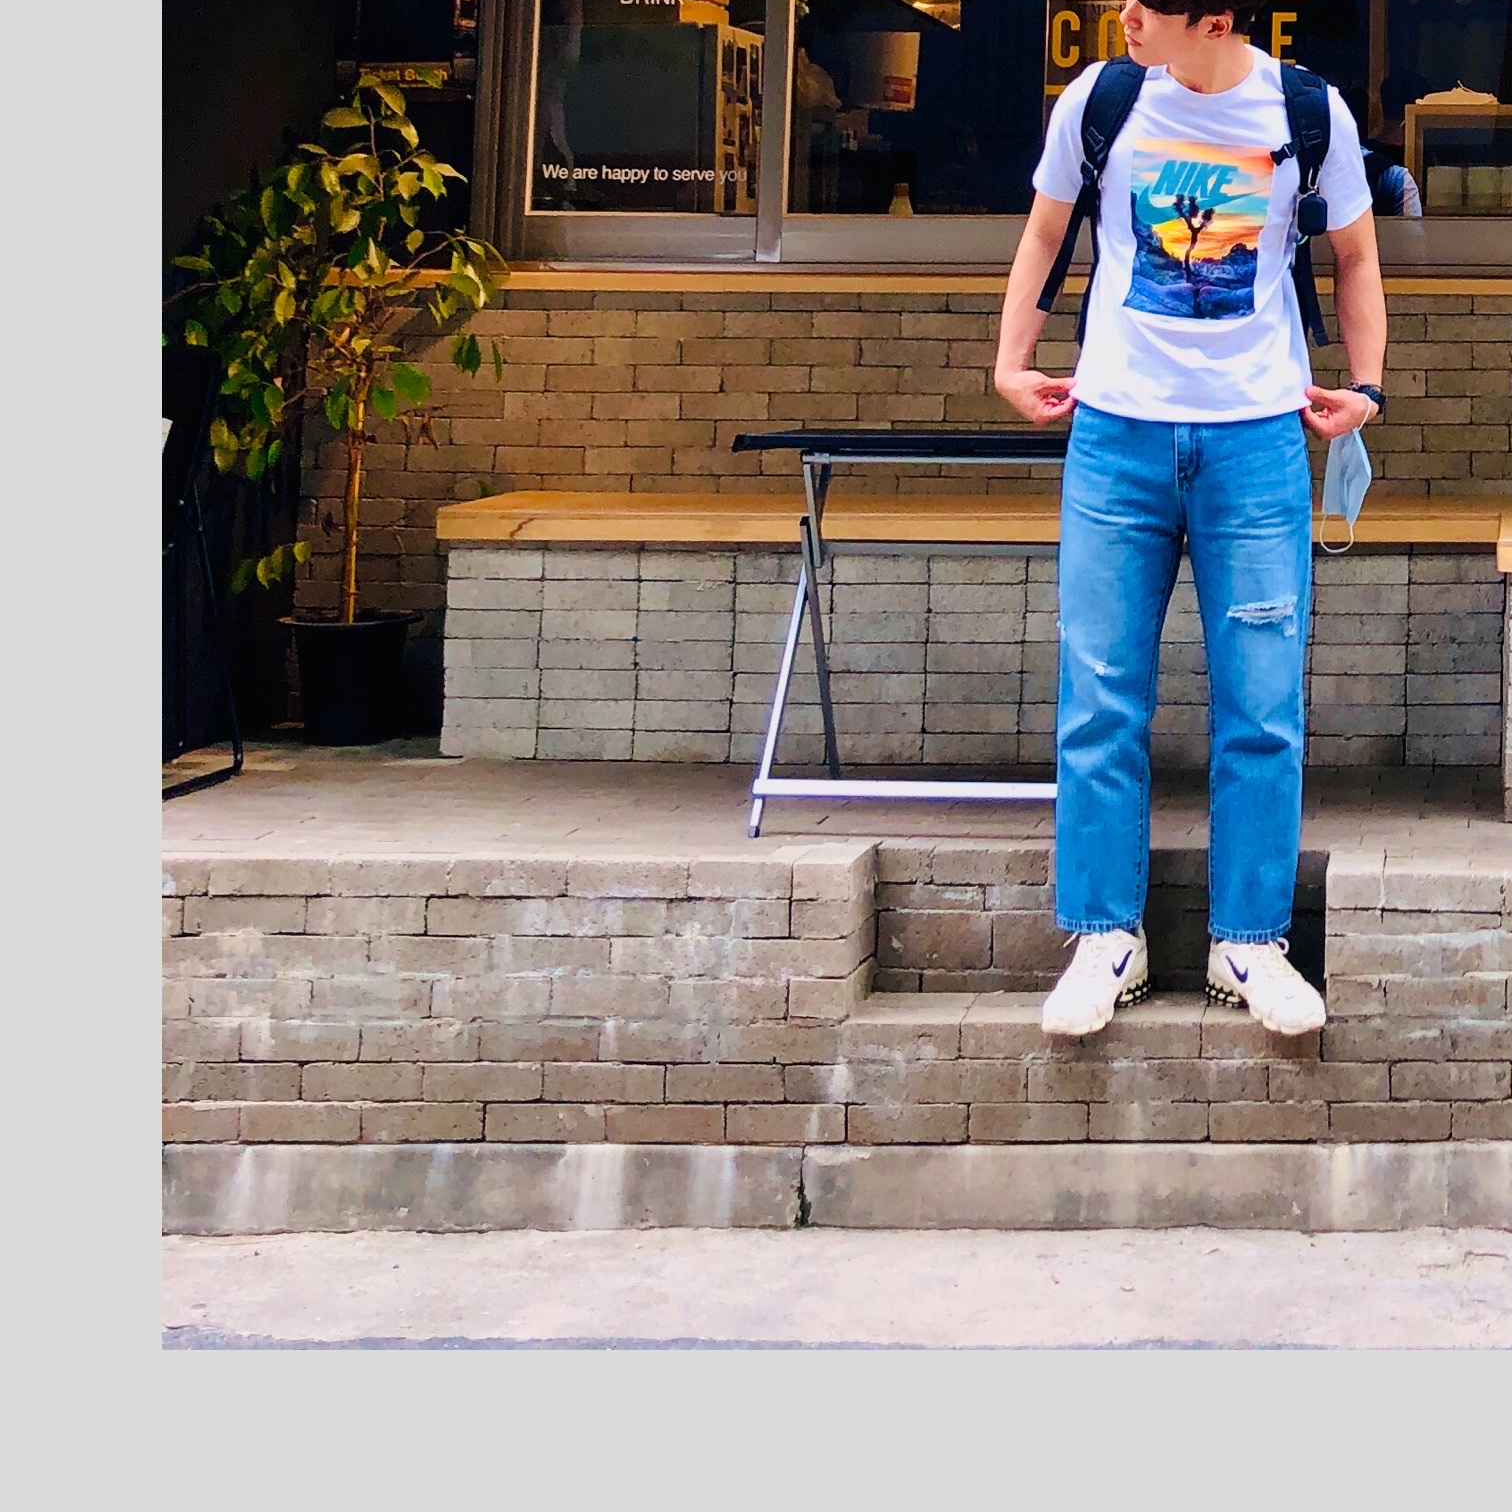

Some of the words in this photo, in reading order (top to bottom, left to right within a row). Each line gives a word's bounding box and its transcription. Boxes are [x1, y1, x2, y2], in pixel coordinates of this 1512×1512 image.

[541, 164, 569, 180] We
[572, 167, 598, 180] are
[602, 164, 650, 184] happy
[653, 165, 669, 181] to
[672, 168, 715, 181] serve
[718, 169, 748, 184] you
[1151, 159, 1240, 197] NIKE
